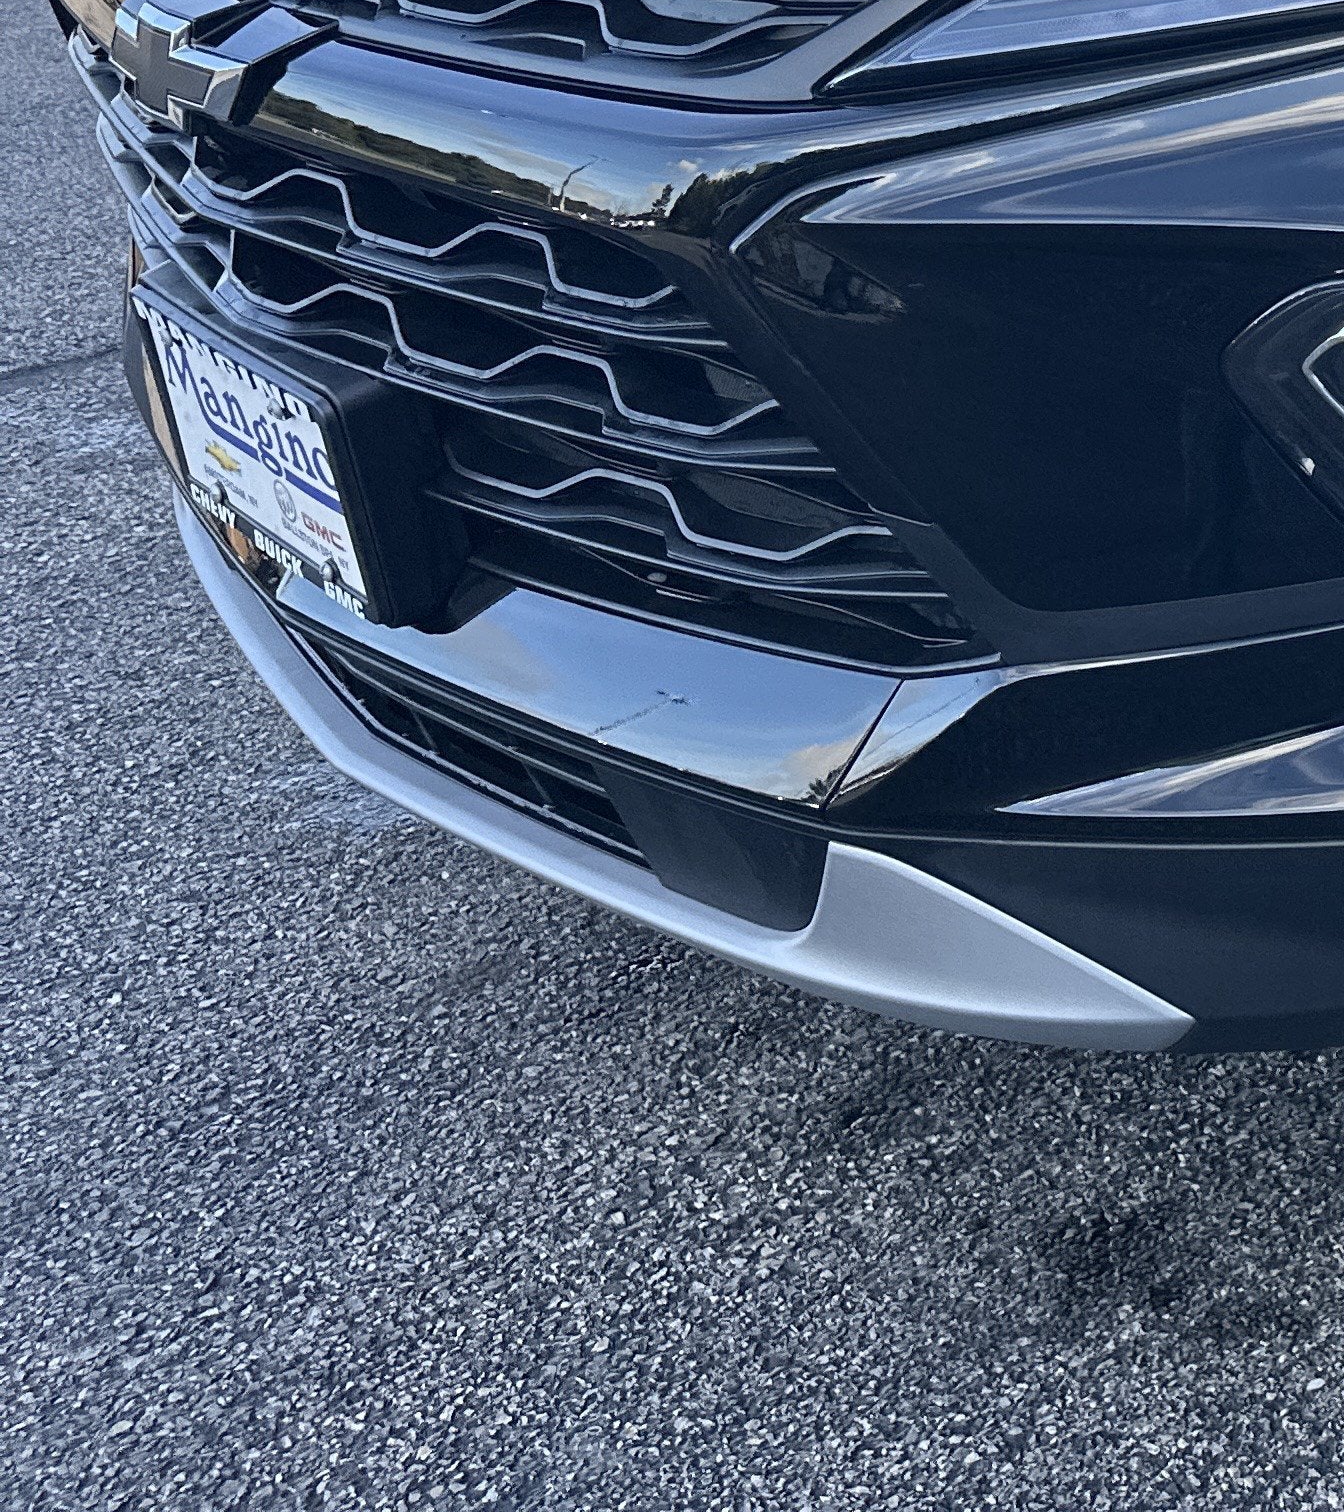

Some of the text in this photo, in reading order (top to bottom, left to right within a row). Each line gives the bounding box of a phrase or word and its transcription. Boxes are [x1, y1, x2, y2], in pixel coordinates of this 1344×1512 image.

[163, 343, 338, 492] Mangino
[190, 483, 366, 620] CHEVY BUICK GMC
[301, 511, 347, 552] GMC
